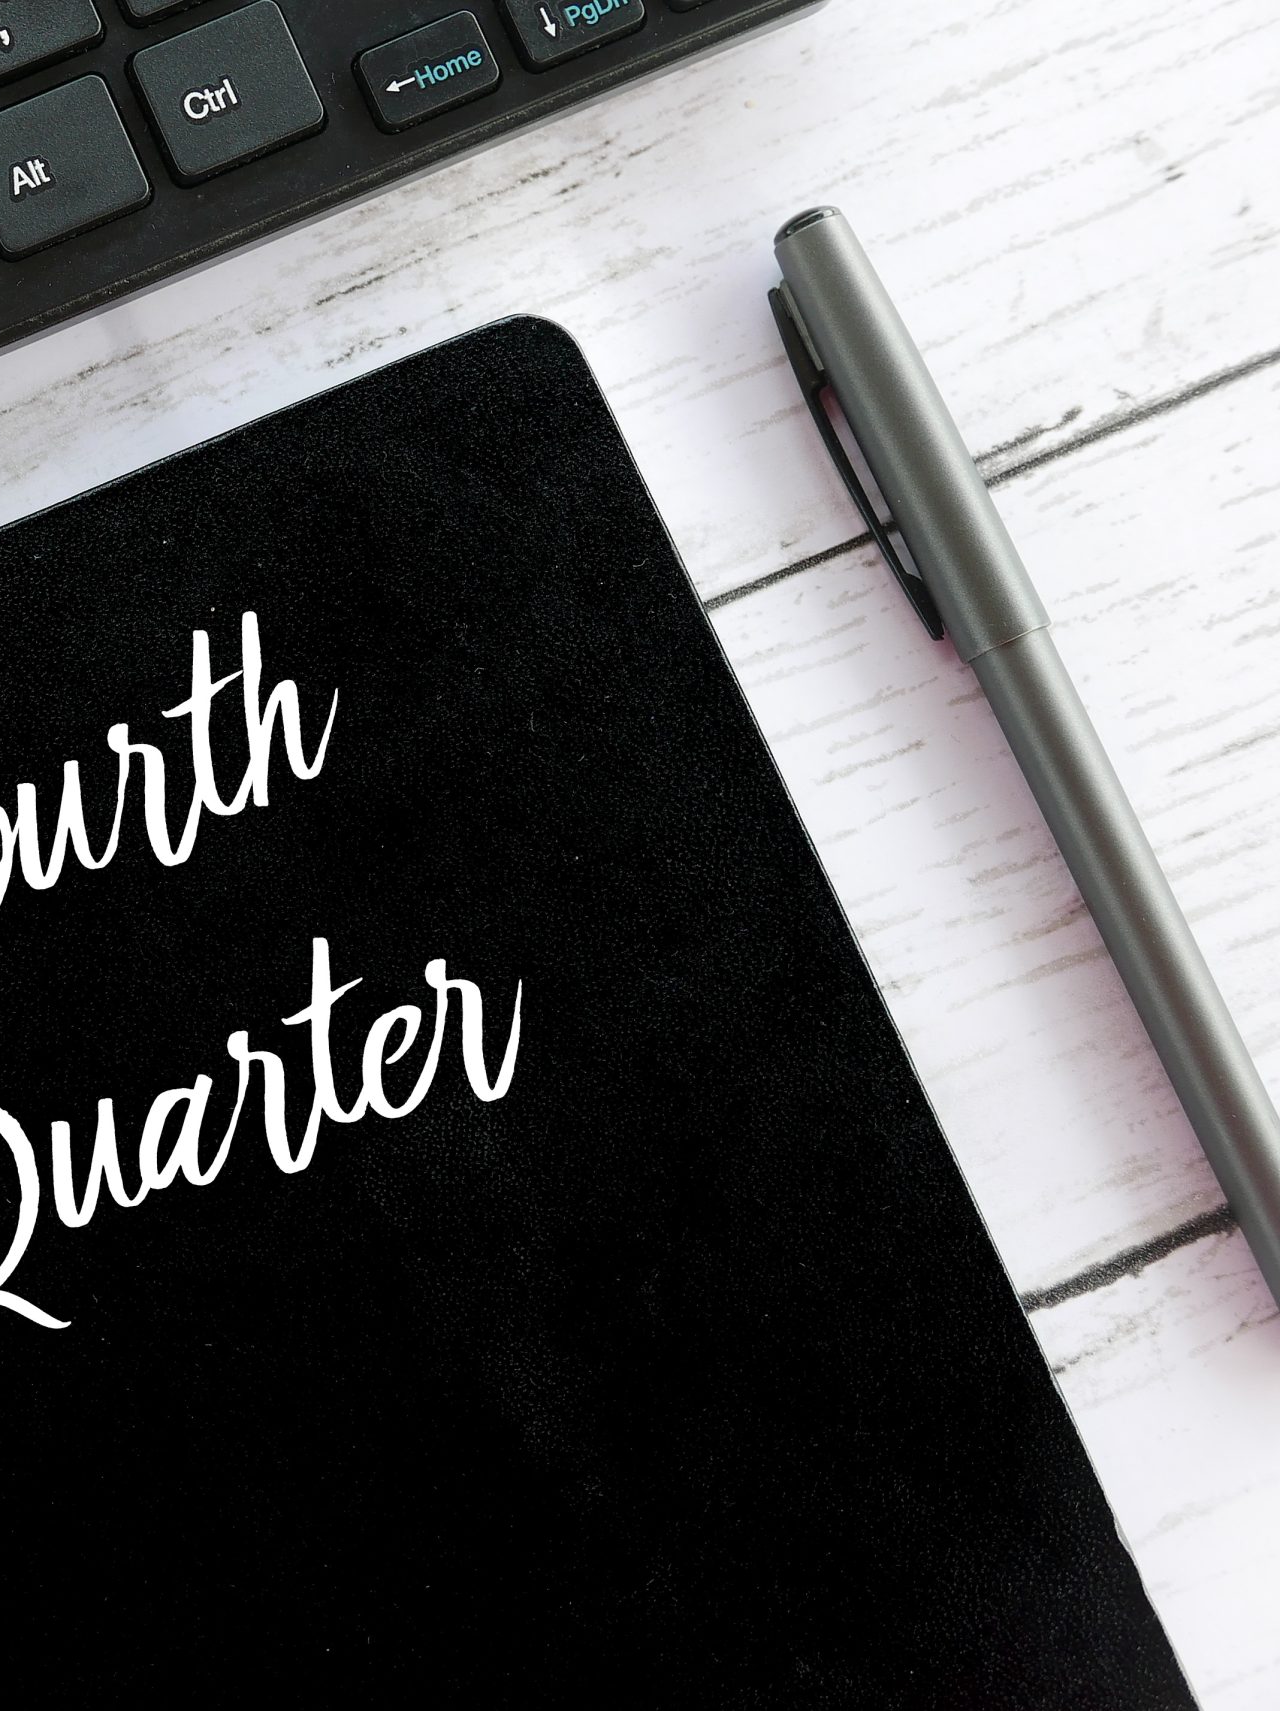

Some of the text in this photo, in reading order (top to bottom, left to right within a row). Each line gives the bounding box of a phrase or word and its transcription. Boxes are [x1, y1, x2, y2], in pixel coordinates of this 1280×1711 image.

[414, 49, 482, 89] Home
[183, 78, 238, 119] Ctrl
[12, 158, 51, 196] Alt
